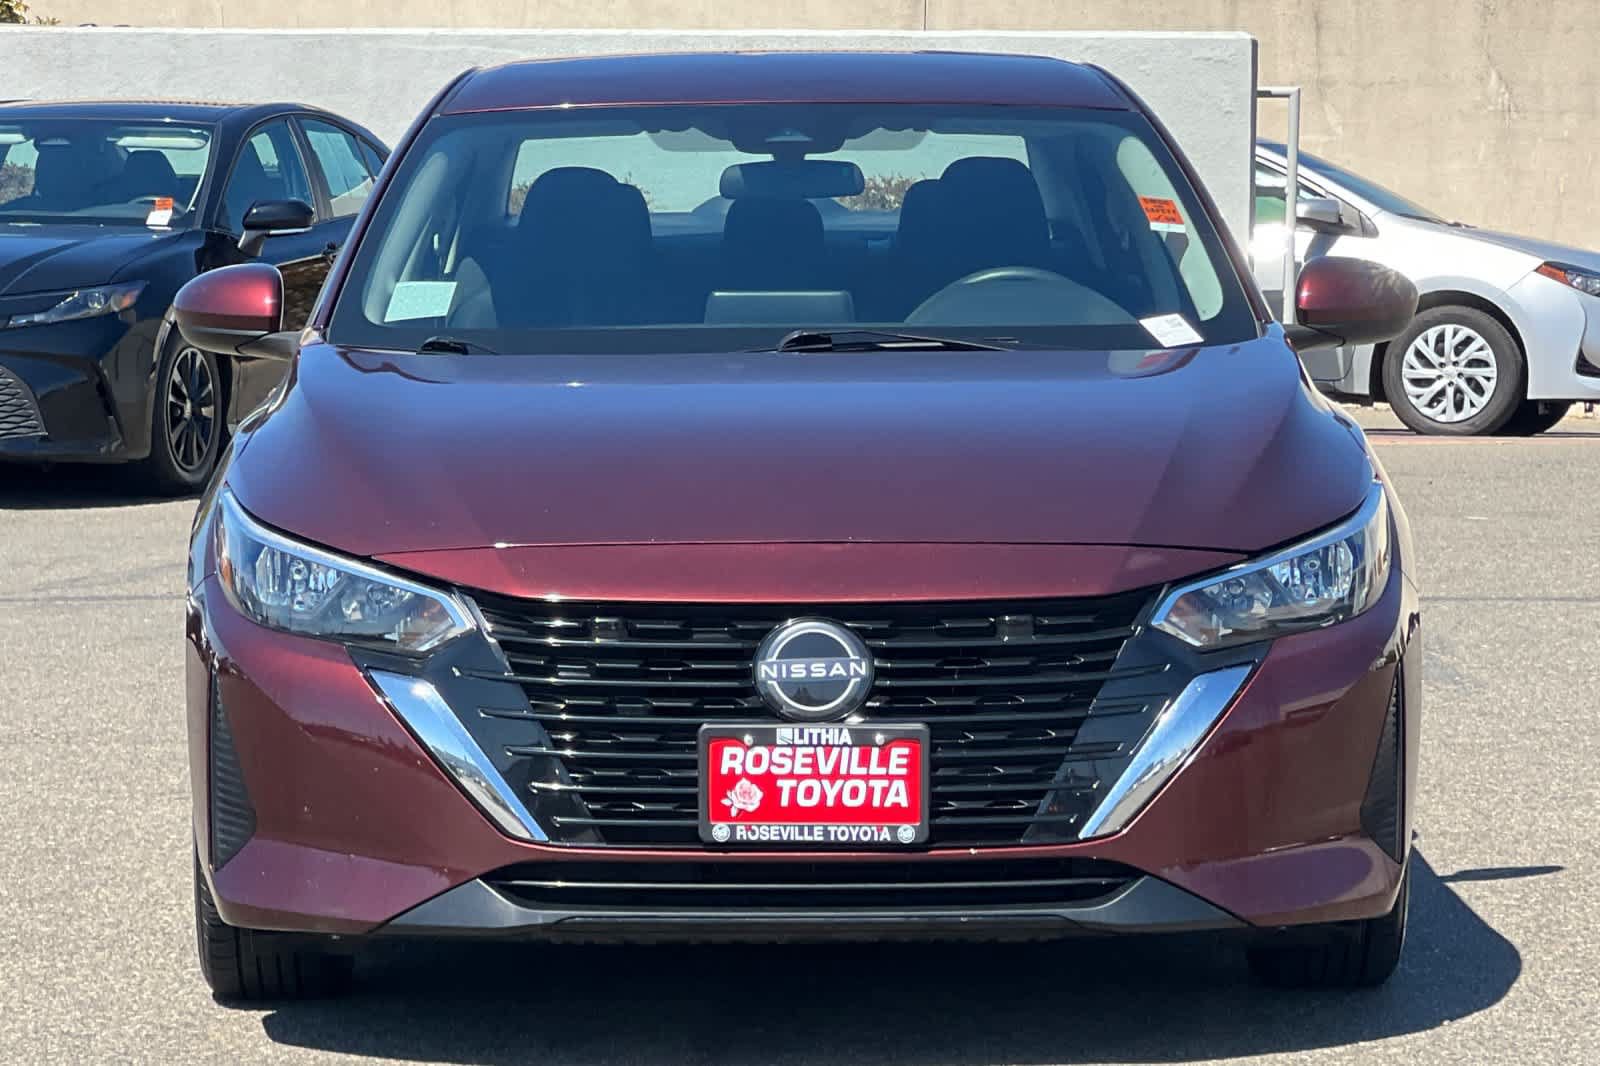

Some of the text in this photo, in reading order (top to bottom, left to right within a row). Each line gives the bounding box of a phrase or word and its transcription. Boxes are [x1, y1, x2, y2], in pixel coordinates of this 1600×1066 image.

[761, 661, 866, 679] NISSAN
[794, 728, 852, 745] LITHIA
[720, 747, 910, 775] ROSEVILLE
[776, 779, 909, 808] TOYOTA
[736, 826, 891, 841] ROSEVILLE TOYOTA
